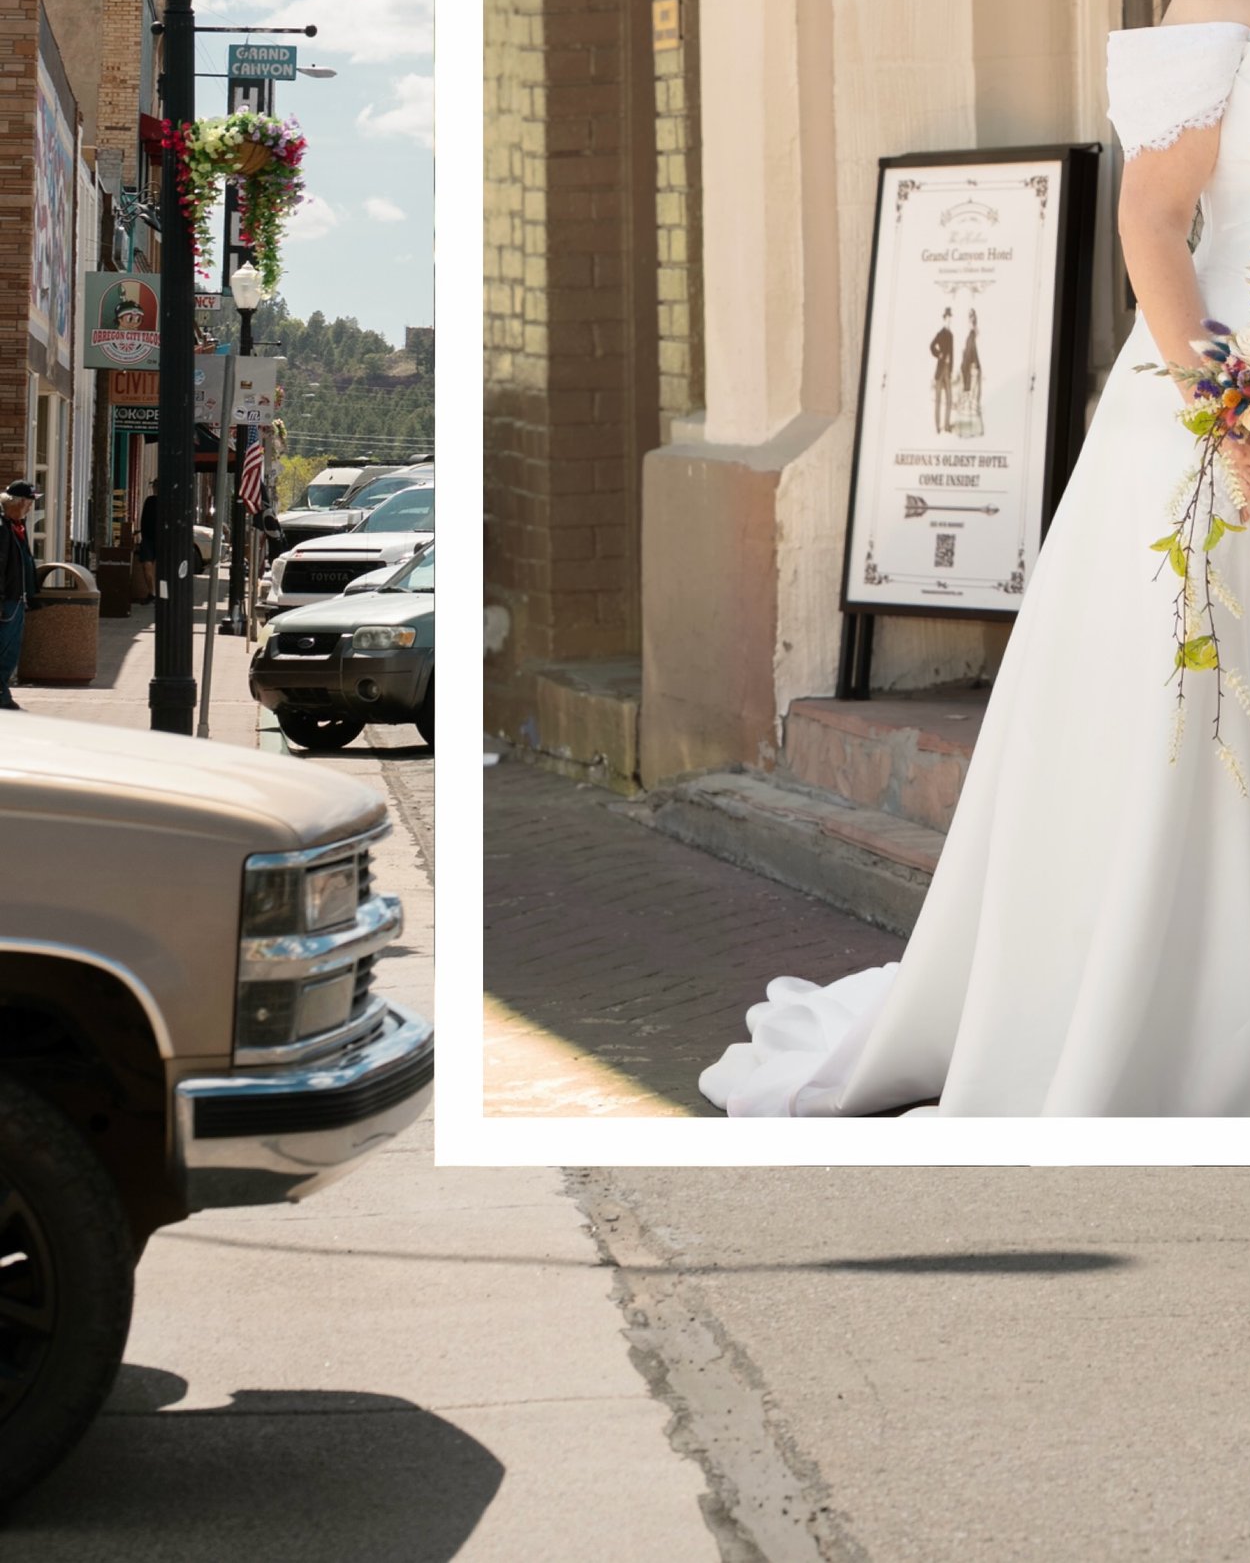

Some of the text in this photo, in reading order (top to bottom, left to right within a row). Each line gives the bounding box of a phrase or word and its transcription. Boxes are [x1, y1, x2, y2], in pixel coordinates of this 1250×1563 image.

[231, 46, 293, 76] GRAND CANYON
[921, 247, 1013, 263] Grand Canyon Hotel
[126, 331, 140, 340] CITY
[894, 453, 1009, 468] ARIZONA'S OLDEST HOTEL
[919, 474, 980, 487] COME INSIDE!
[311, 572, 349, 582] TOYOTA
